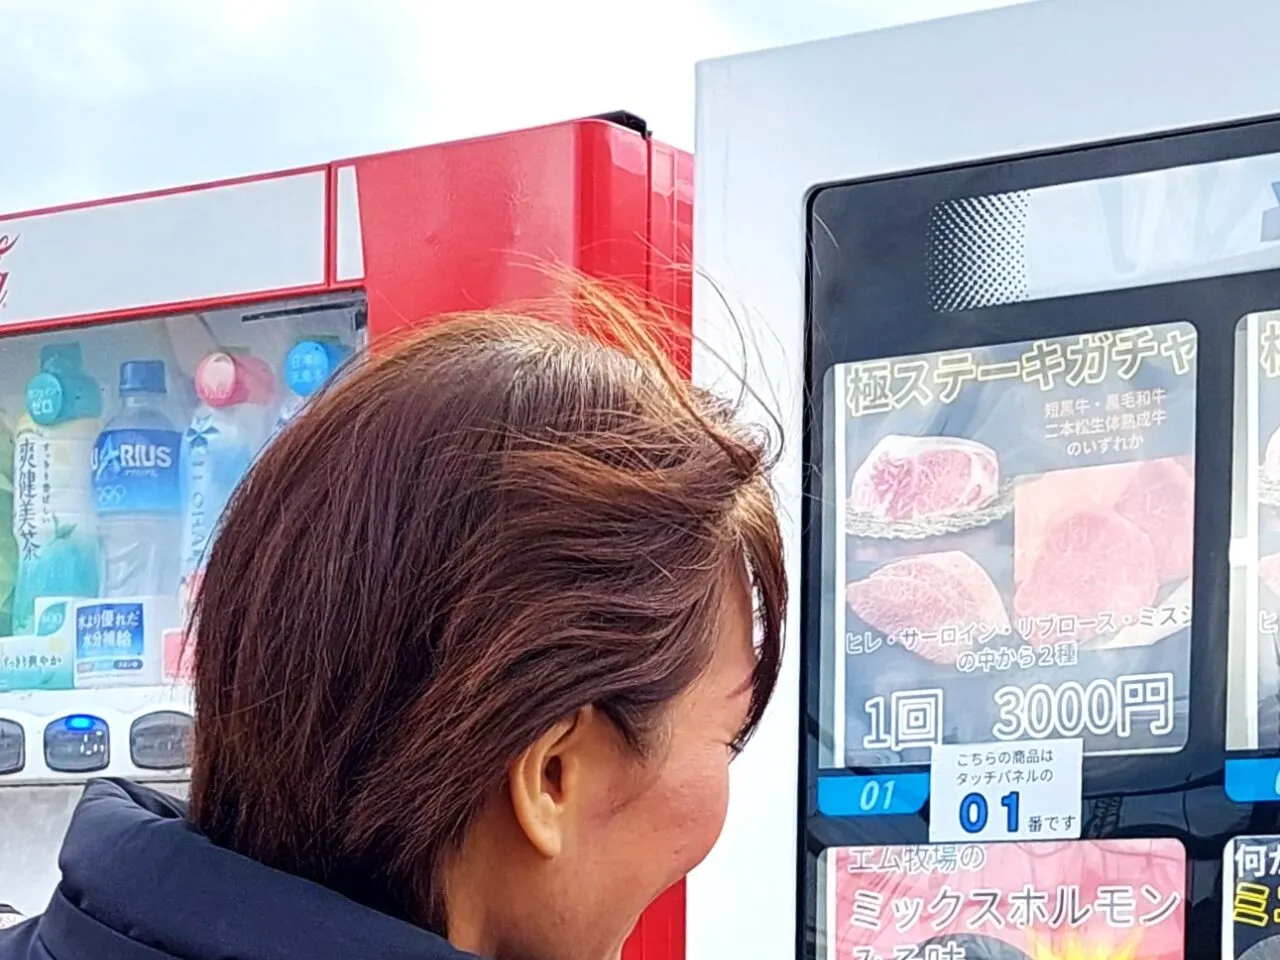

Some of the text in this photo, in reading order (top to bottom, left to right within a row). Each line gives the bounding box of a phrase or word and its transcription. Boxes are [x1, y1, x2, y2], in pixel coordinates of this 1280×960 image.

[847, 326, 1197, 416] 極ステーキガチャ
[1067, 434, 1144, 456] のいずれか
[18, 438, 41, 561] 爽健美茶
[956, 640, 1078, 674] の中から2種
[863, 673, 1175, 750] 1回 3000円
[957, 749, 1053, 767] こちらの商品は
[956, 767, 1053, 786] タッチパネルの
[860, 780, 896, 810] 01
[849, 844, 986, 873] エム牧場の
[851, 884, 1182, 934] ミックスホルモン
